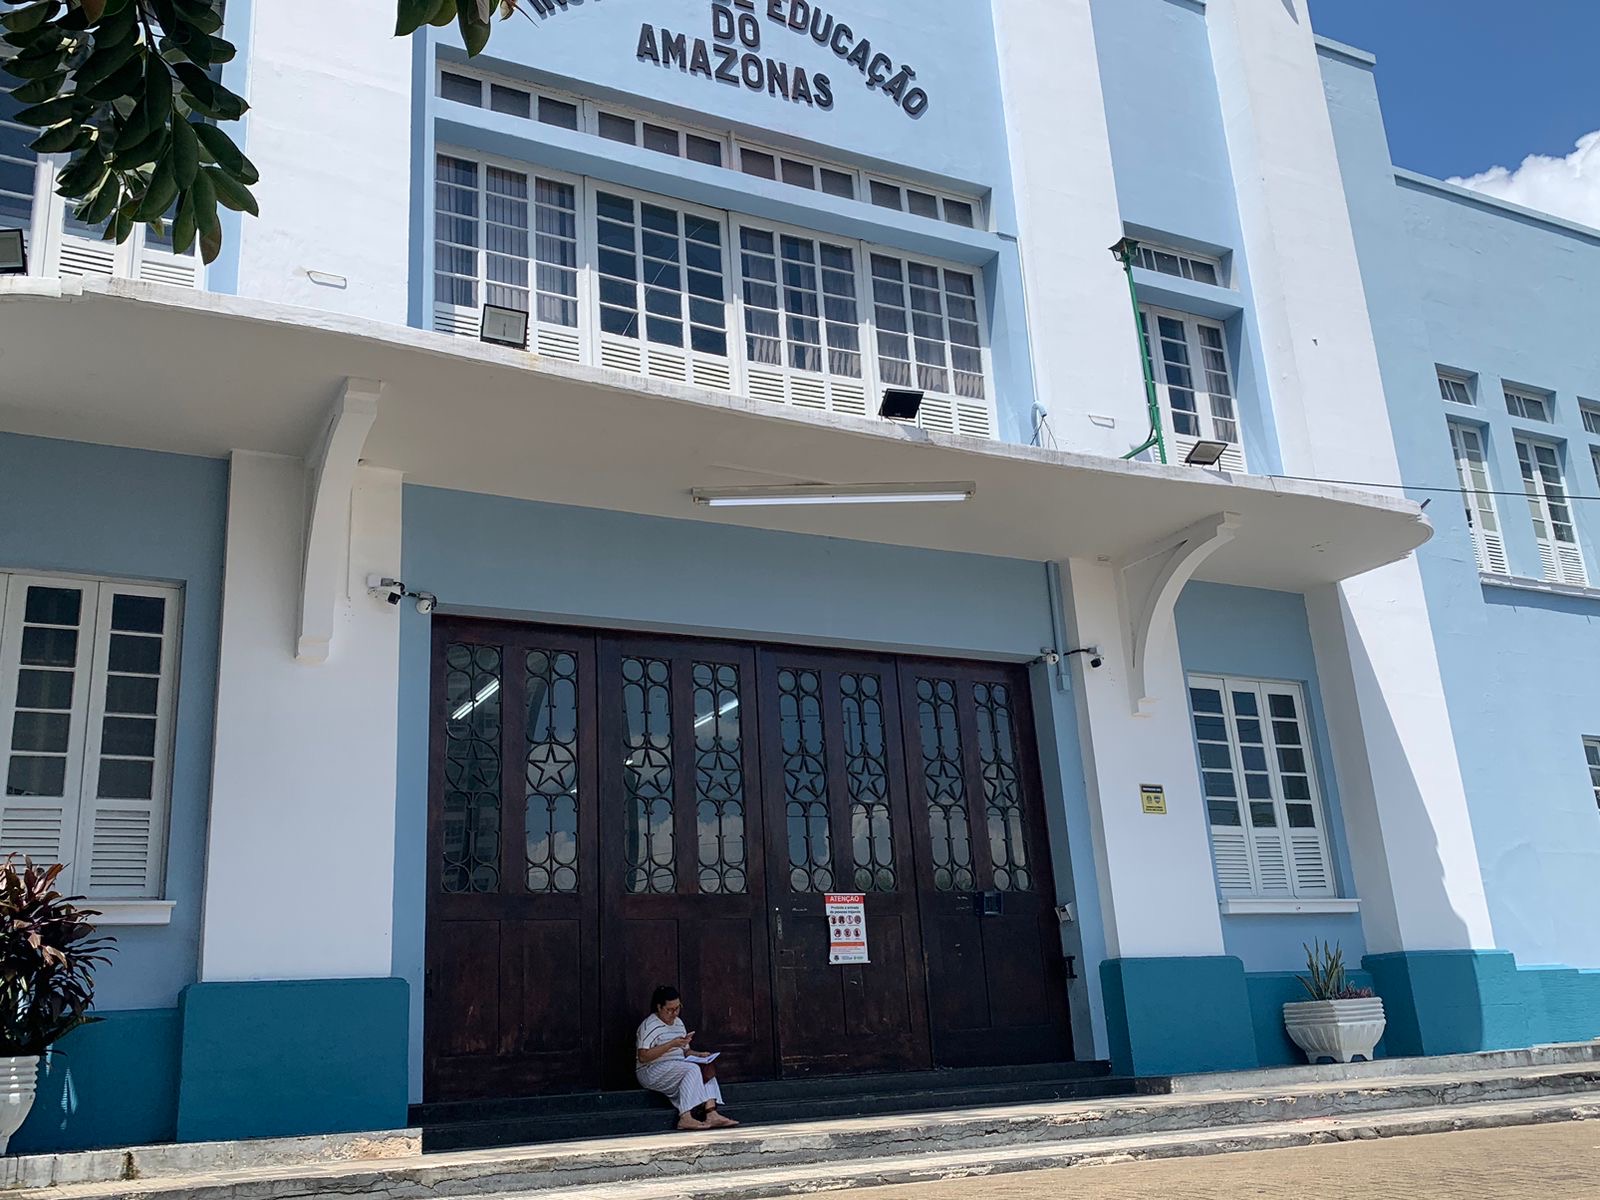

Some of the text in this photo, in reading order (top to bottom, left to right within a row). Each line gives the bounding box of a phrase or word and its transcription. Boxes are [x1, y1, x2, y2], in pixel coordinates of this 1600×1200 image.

[636, 23, 833, 109] AMAZONAS
[711, 4, 760, 48] DO
[767, 0, 928, 115] EDUCAÇÃO
